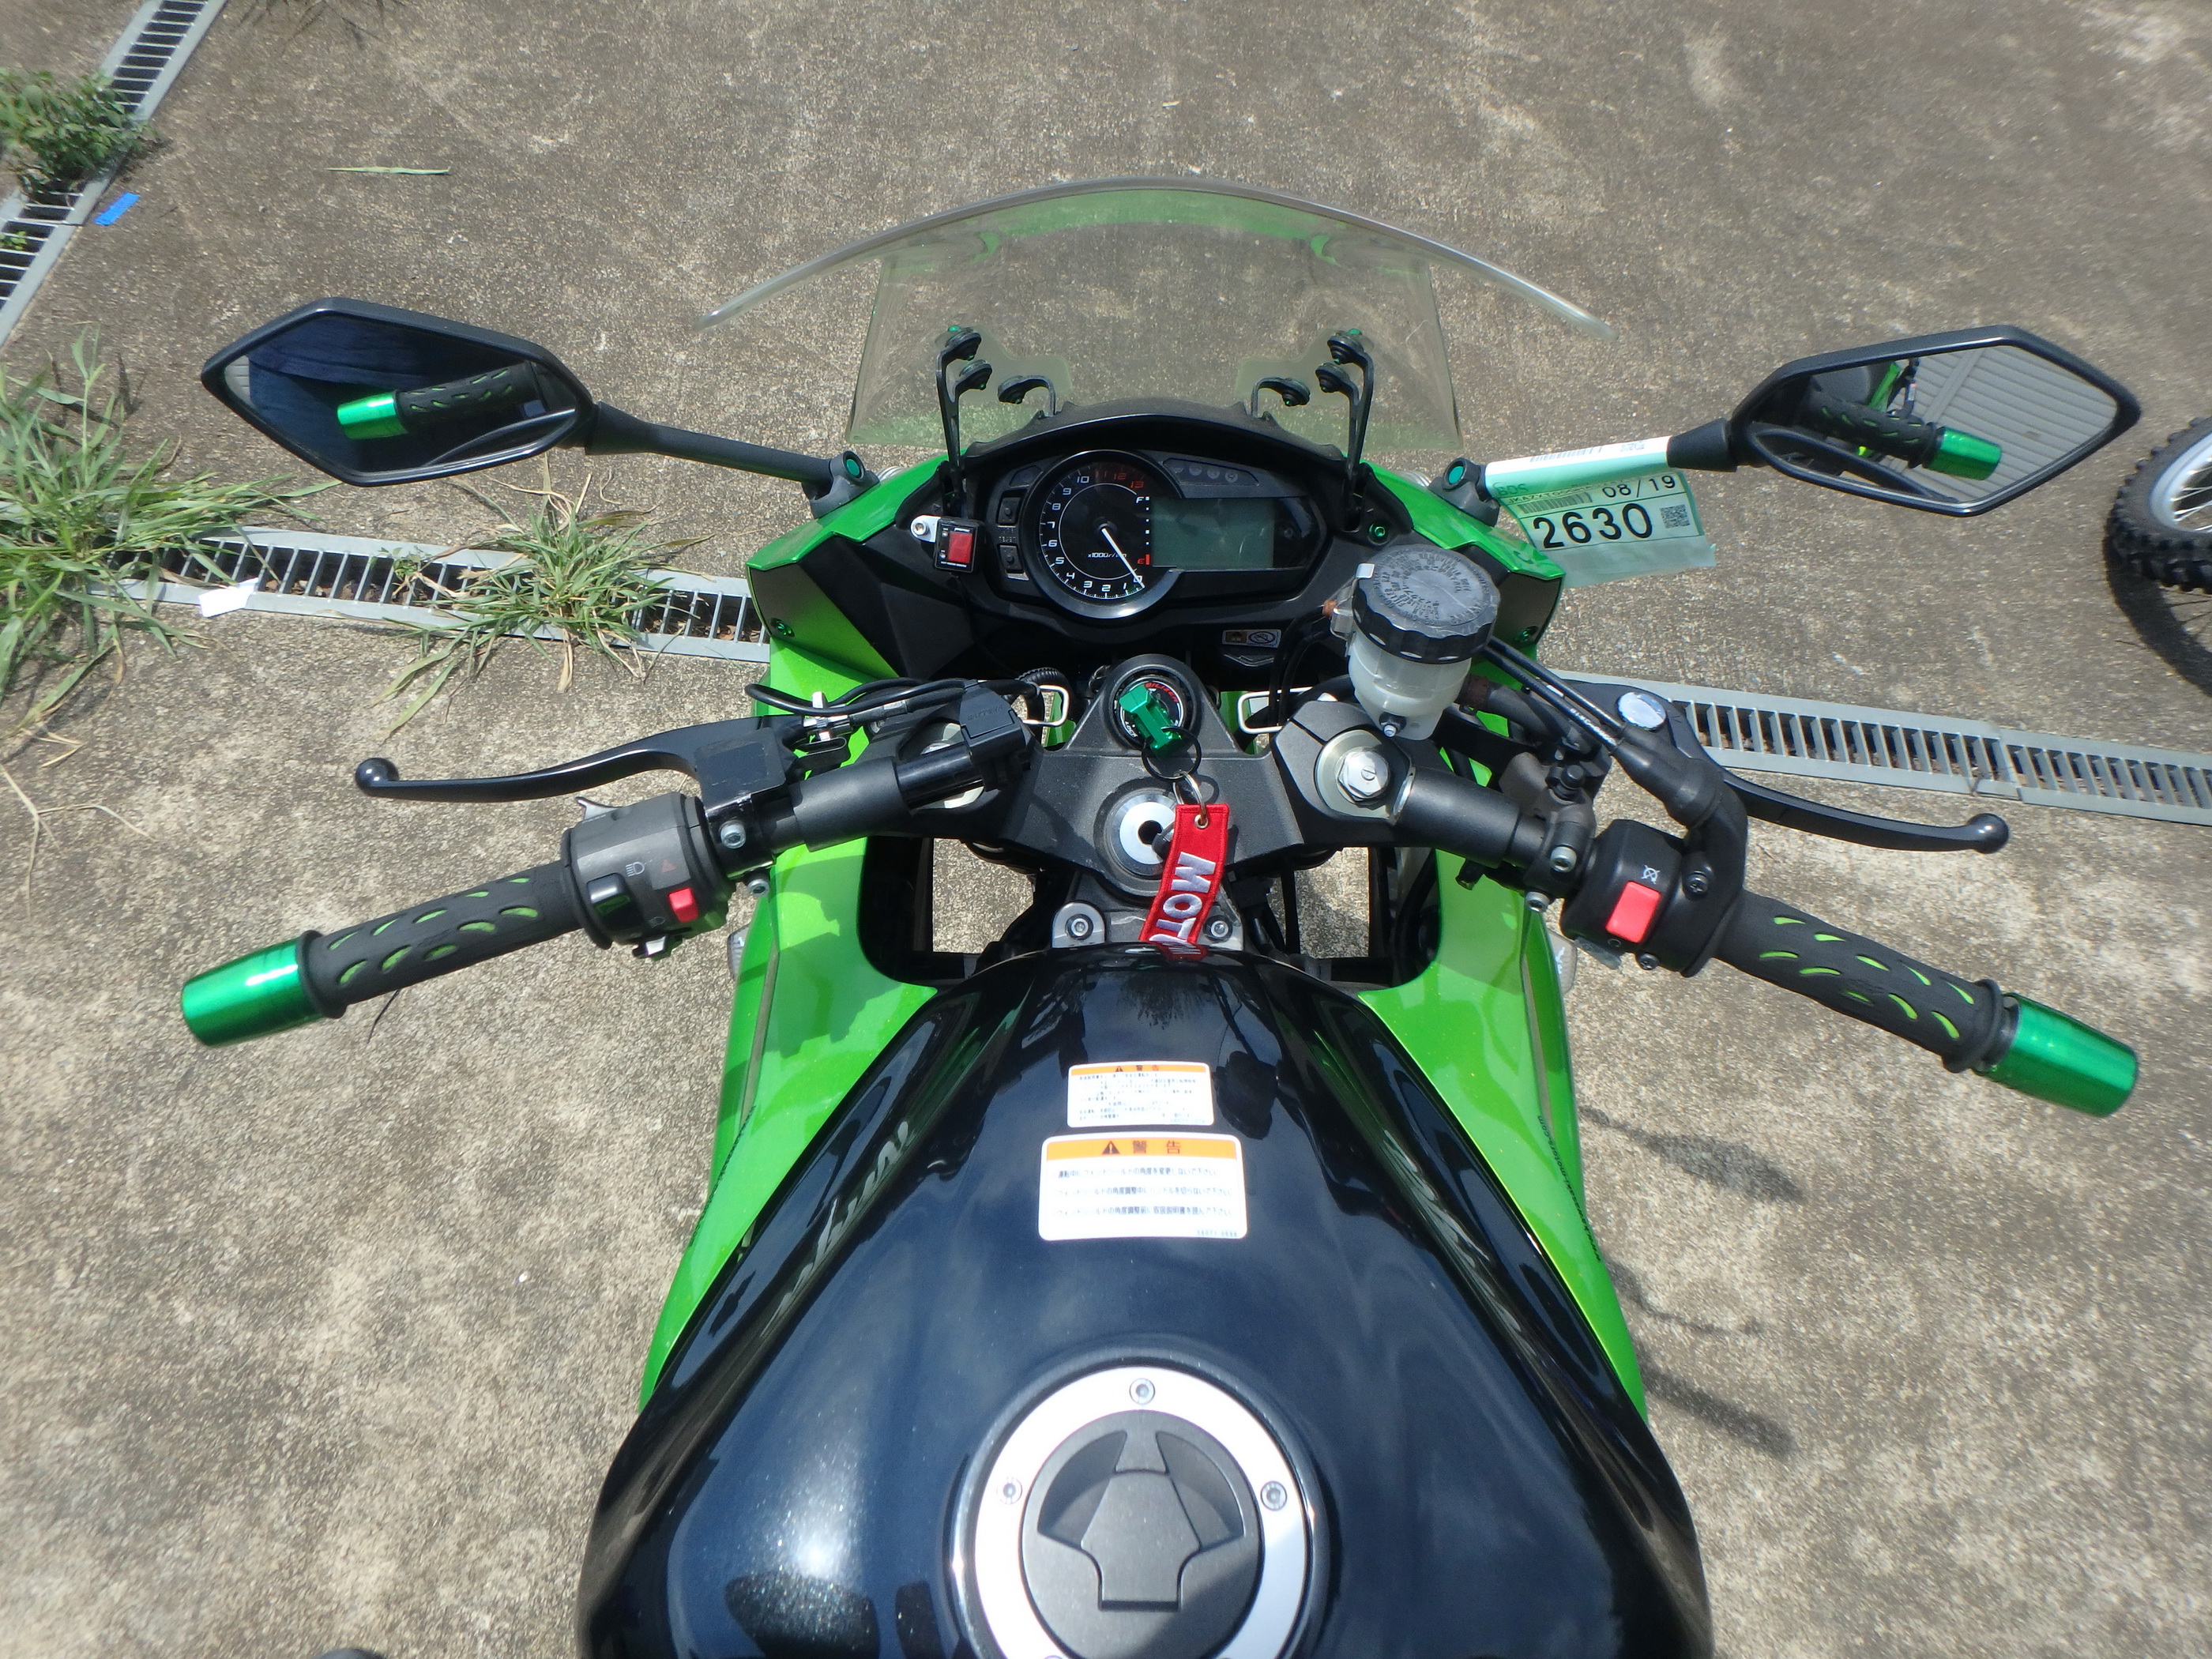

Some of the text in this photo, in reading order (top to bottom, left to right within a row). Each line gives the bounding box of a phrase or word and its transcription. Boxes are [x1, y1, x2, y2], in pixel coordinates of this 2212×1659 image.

[1602, 475, 1676, 498] 08/19
[1533, 503, 1653, 549] 2630
[1124, 721, 1138, 738] LOCK
[1132, 1140, 1182, 1155] 警告
